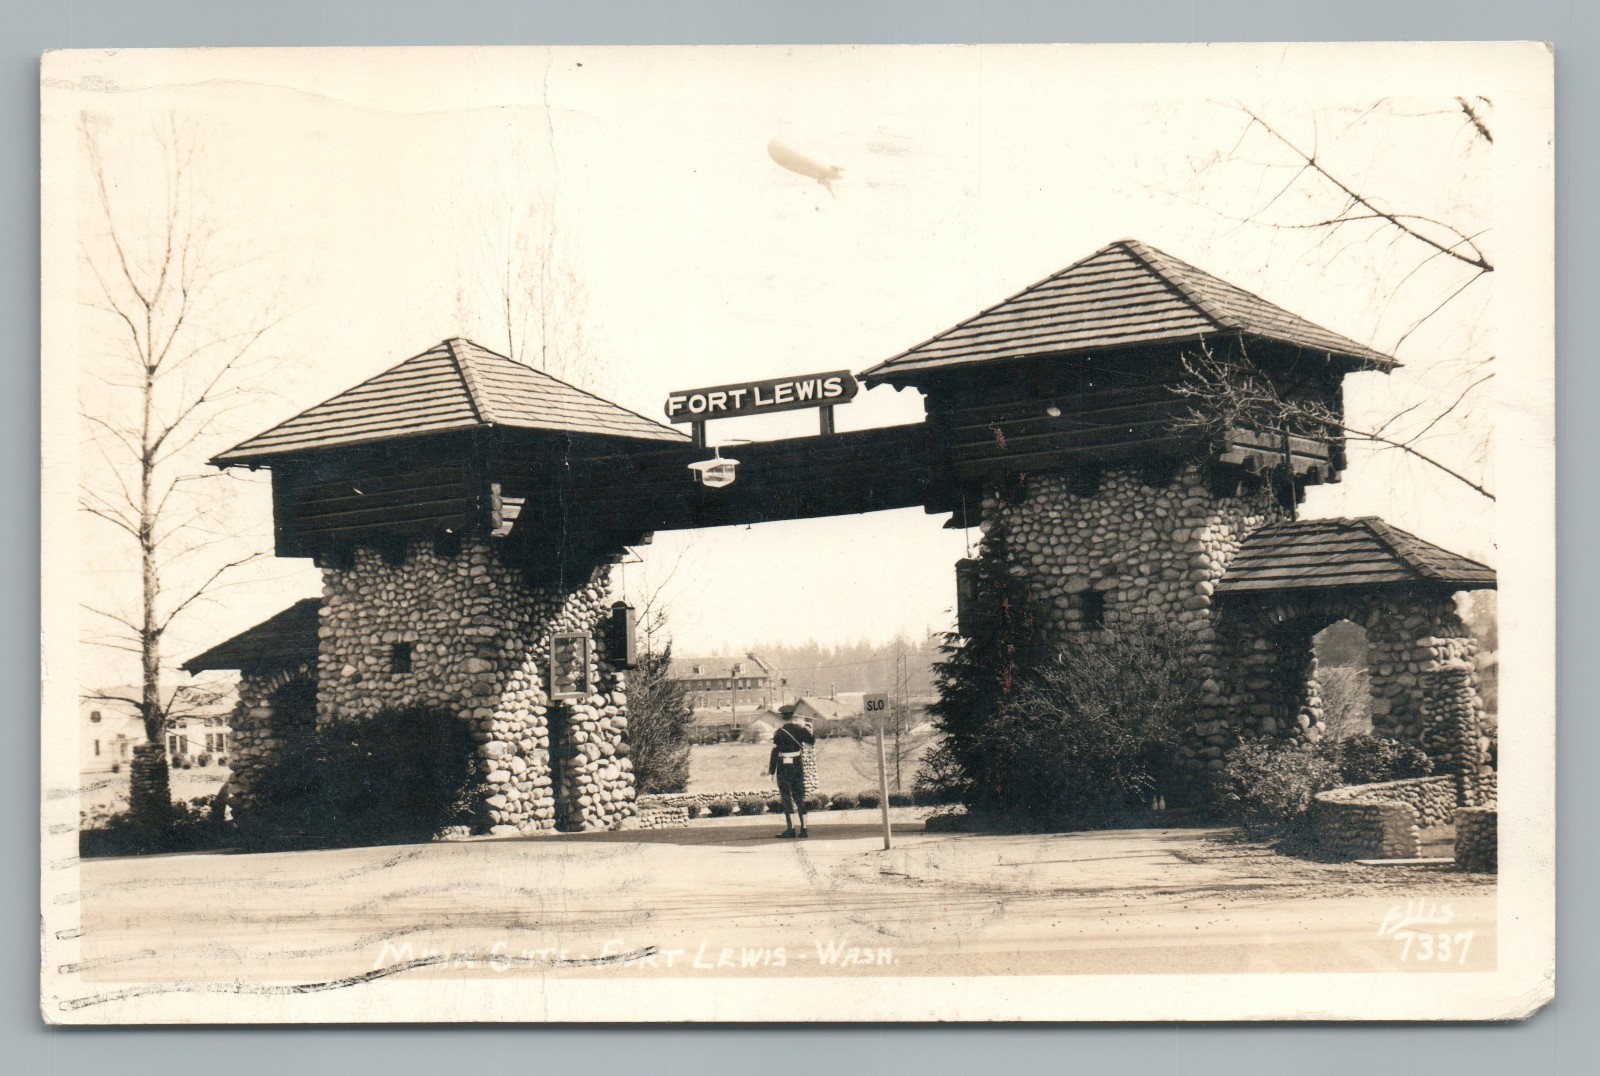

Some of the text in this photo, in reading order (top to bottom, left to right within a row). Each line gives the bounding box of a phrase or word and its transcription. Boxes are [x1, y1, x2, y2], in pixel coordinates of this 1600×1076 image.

[668, 377, 843, 417] FORT LEWIS
[866, 699, 885, 712] SLO
